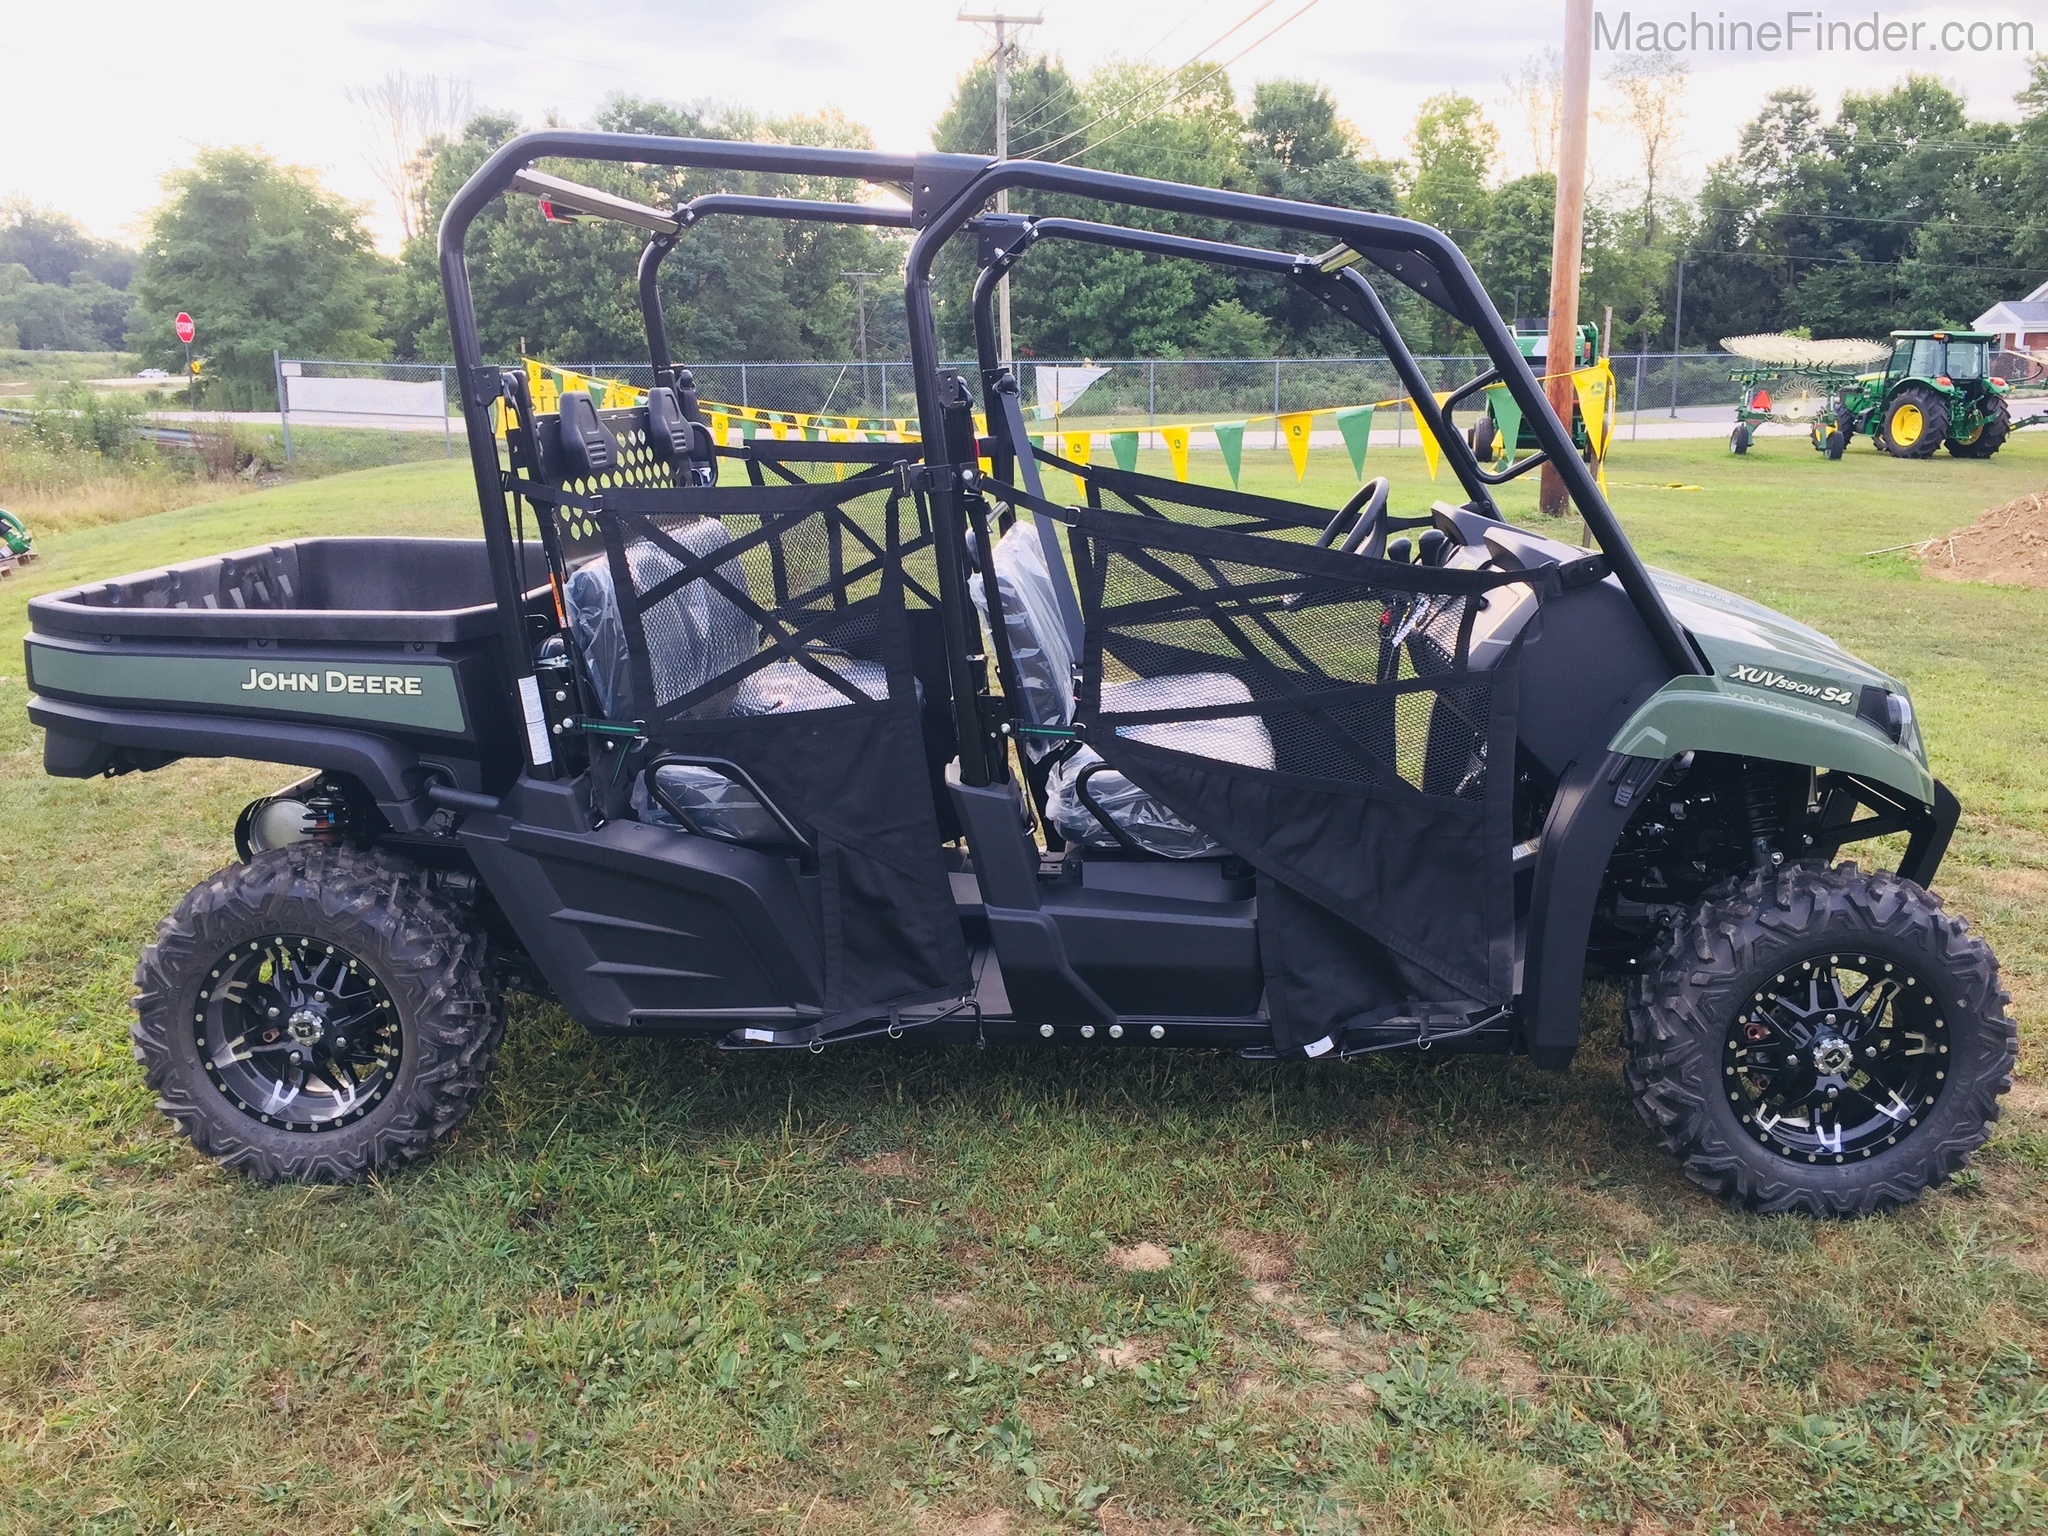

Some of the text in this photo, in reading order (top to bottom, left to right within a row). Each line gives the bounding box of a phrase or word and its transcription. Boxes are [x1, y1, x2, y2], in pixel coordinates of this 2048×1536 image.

[177, 322, 192, 334] STOP
[1686, 585, 1731, 604] Steering
[241, 668, 423, 695] JOHN DEERE
[1729, 664, 1853, 705] XUV590M S4
